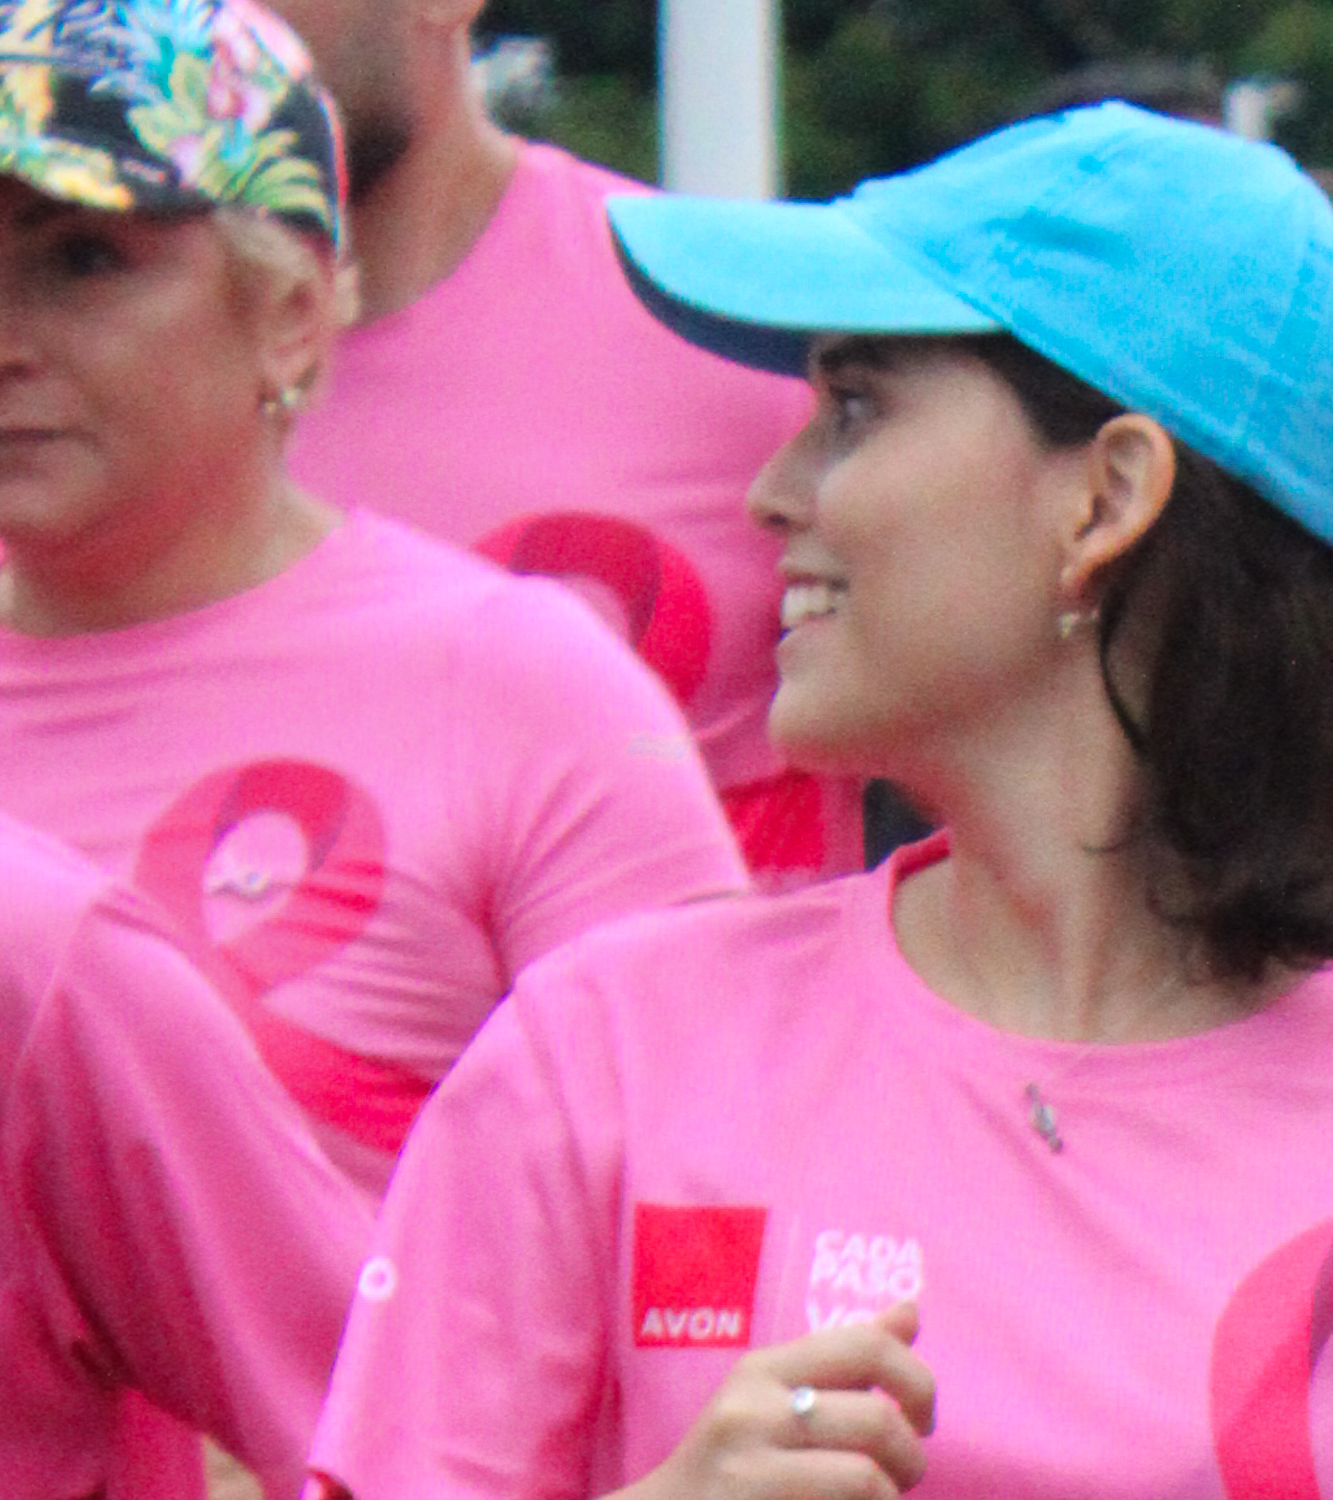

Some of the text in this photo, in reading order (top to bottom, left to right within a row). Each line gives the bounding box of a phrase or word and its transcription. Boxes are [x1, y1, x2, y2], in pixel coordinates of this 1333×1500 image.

[814, 1229, 920, 1265] CADA
[810, 1255, 922, 1300] PASO
[640, 1306, 741, 1340] AVON
